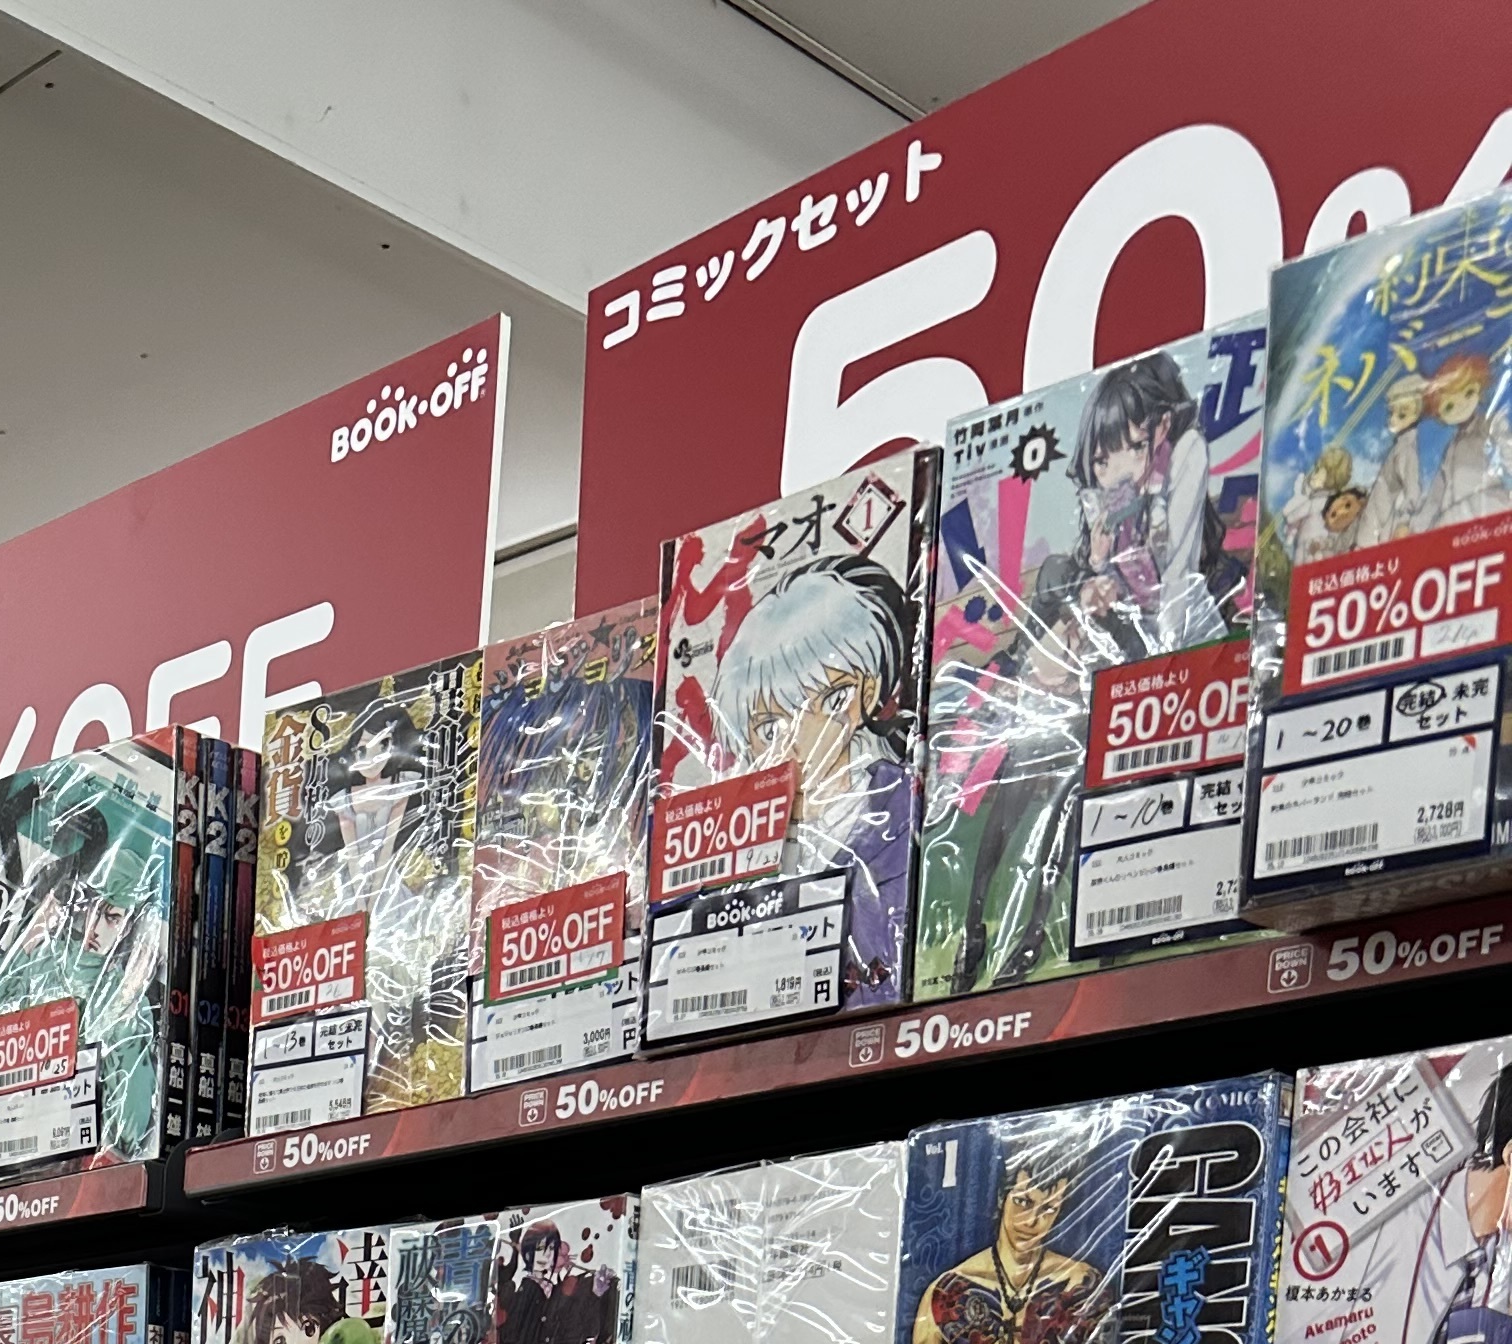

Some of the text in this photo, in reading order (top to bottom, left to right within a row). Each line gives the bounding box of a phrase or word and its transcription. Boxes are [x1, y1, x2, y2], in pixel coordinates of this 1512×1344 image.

[602, 138, 944, 351] コミックセット
[739, 494, 837, 561] マオ
[860, 500, 876, 534] 1
[1304, 553, 1505, 648] 50%OFF
[1307, 559, 1400, 596] 税込価格より
[1110, 668, 1190, 699] 税込価格より
[1106, 678, 1250, 747] 50%OF
[1417, 706, 1468, 732] セット
[664, 798, 722, 823] 税込価格より
[664, 797, 788, 866] 50%OFF
[501, 902, 616, 967] 50%OFF
[1326, 924, 1504, 982] 50%OFF
[262, 940, 357, 993] 50%OFF
[894, 1011, 1033, 1060] 50%OFF
[168, 1042, 185, 1137] 真船一雄
[554, 1079, 665, 1120] 50%OFF
[283, 1133, 372, 1169] 50%OFF
[1294, 1074, 1420, 1180] この会社に
[1352, 1149, 1424, 1215] います
[1285, 1285, 1374, 1306] 榎本あかまる
[1304, 1304, 1375, 1340] Akamaru
